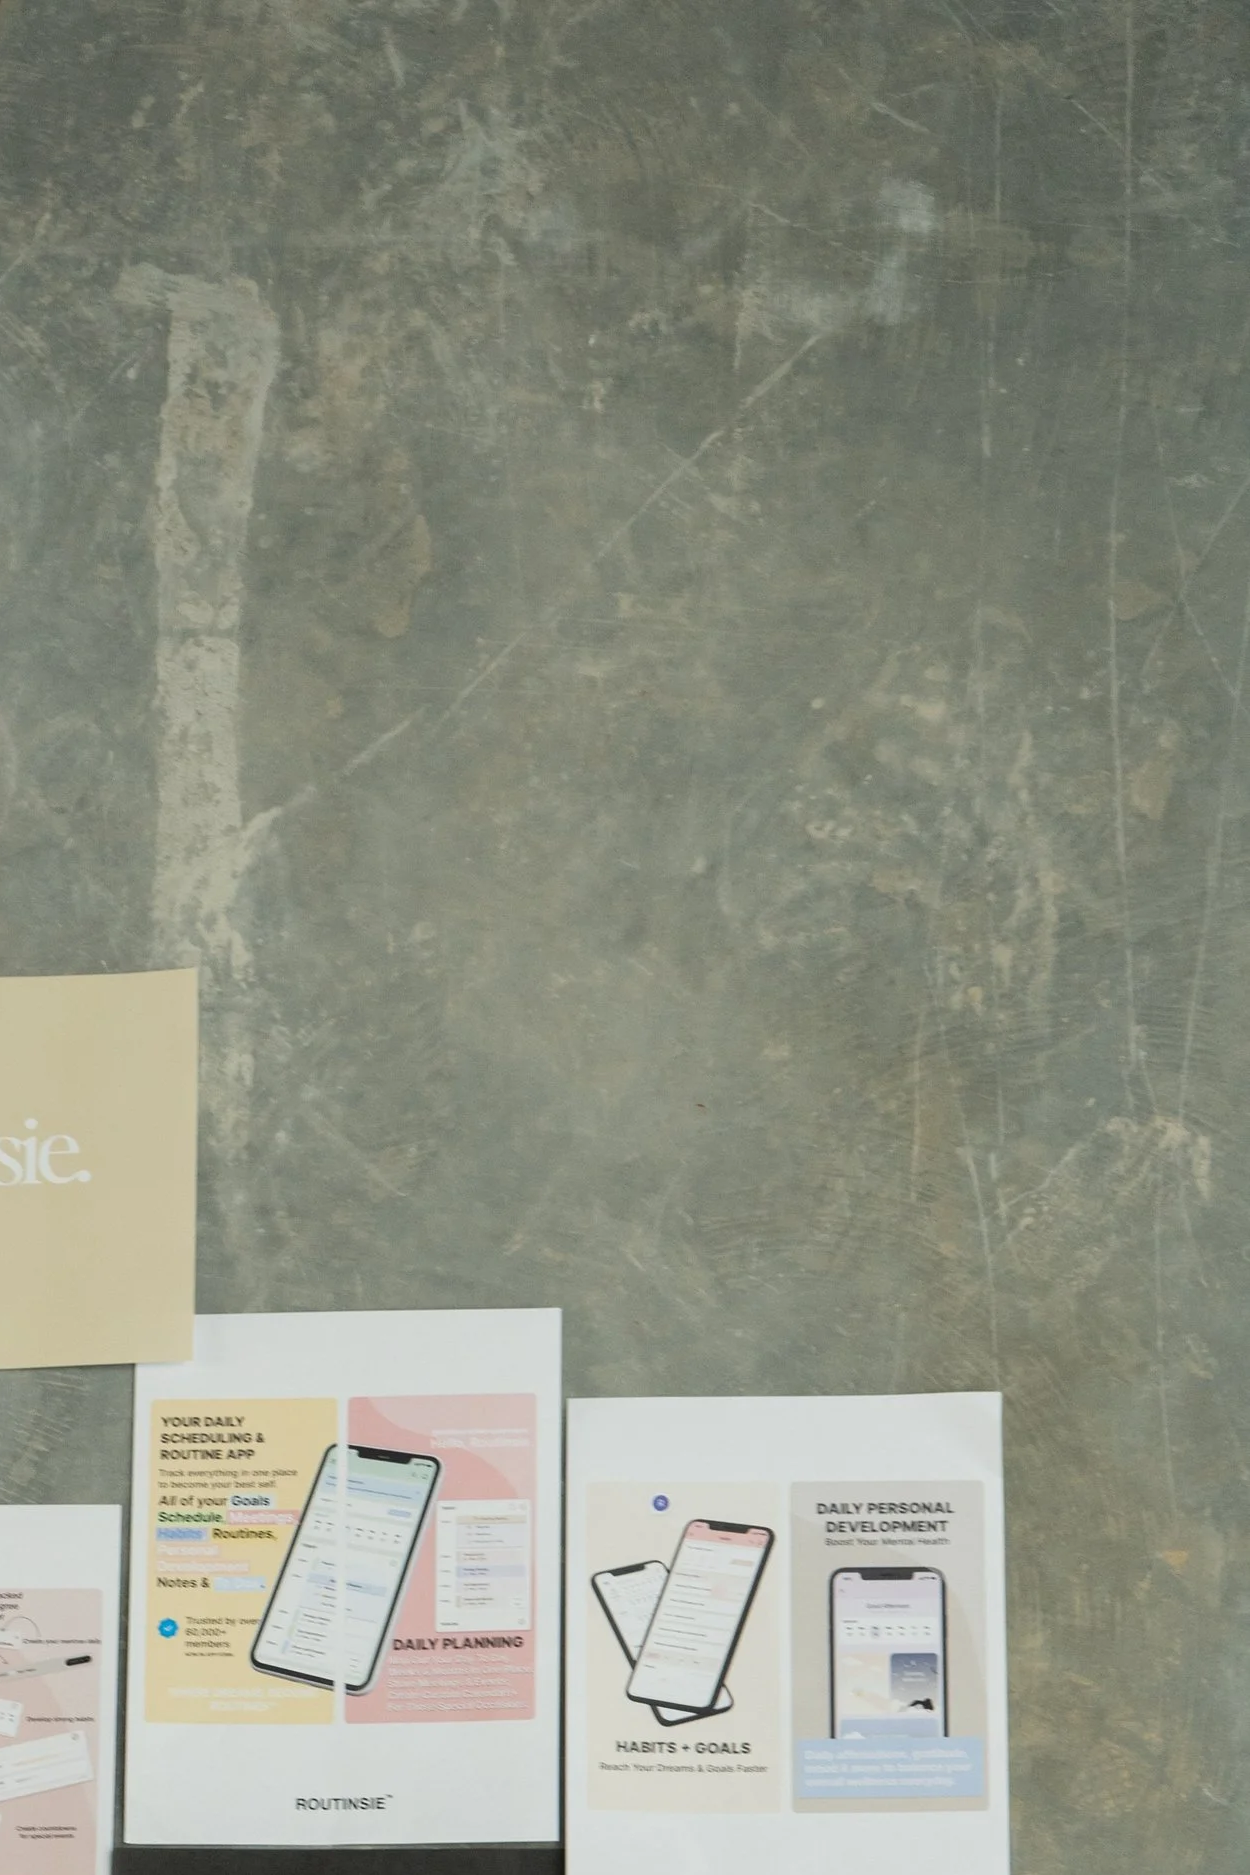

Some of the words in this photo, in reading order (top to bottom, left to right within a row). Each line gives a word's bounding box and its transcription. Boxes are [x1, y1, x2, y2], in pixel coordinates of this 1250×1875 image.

[160, 1416, 201, 1427] YOUR
[204, 1416, 245, 1427] DAILY
[160, 1432, 252, 1444] SCHEDULING
[256, 1432, 266, 1443] &
[160, 1448, 223, 1460] ROUTINE
[226, 1448, 255, 1460] APP
[158, 1495, 177, 1506] All
[180, 1495, 194, 1506] of
[197, 1497, 228, 1509] your
[231, 1495, 271, 1506] Goals
[816, 1502, 863, 1514] DAILY
[867, 1502, 956, 1514] PERSONAL
[825, 1520, 950, 1532] DEVELOPMENT
[212, 1528, 278, 1541] Routines,
[156, 1577, 198, 1588] Notes
[200, 1577, 211, 1588] &
[393, 1638, 439, 1651] DAILY
[442, 1636, 525, 1649] PLANNING
[615, 1740, 677, 1754] HABITS
[694, 1741, 752, 1754] GOALS
[599, 1762, 630, 1771] Reach
[633, 1763, 654, 1772] Your
